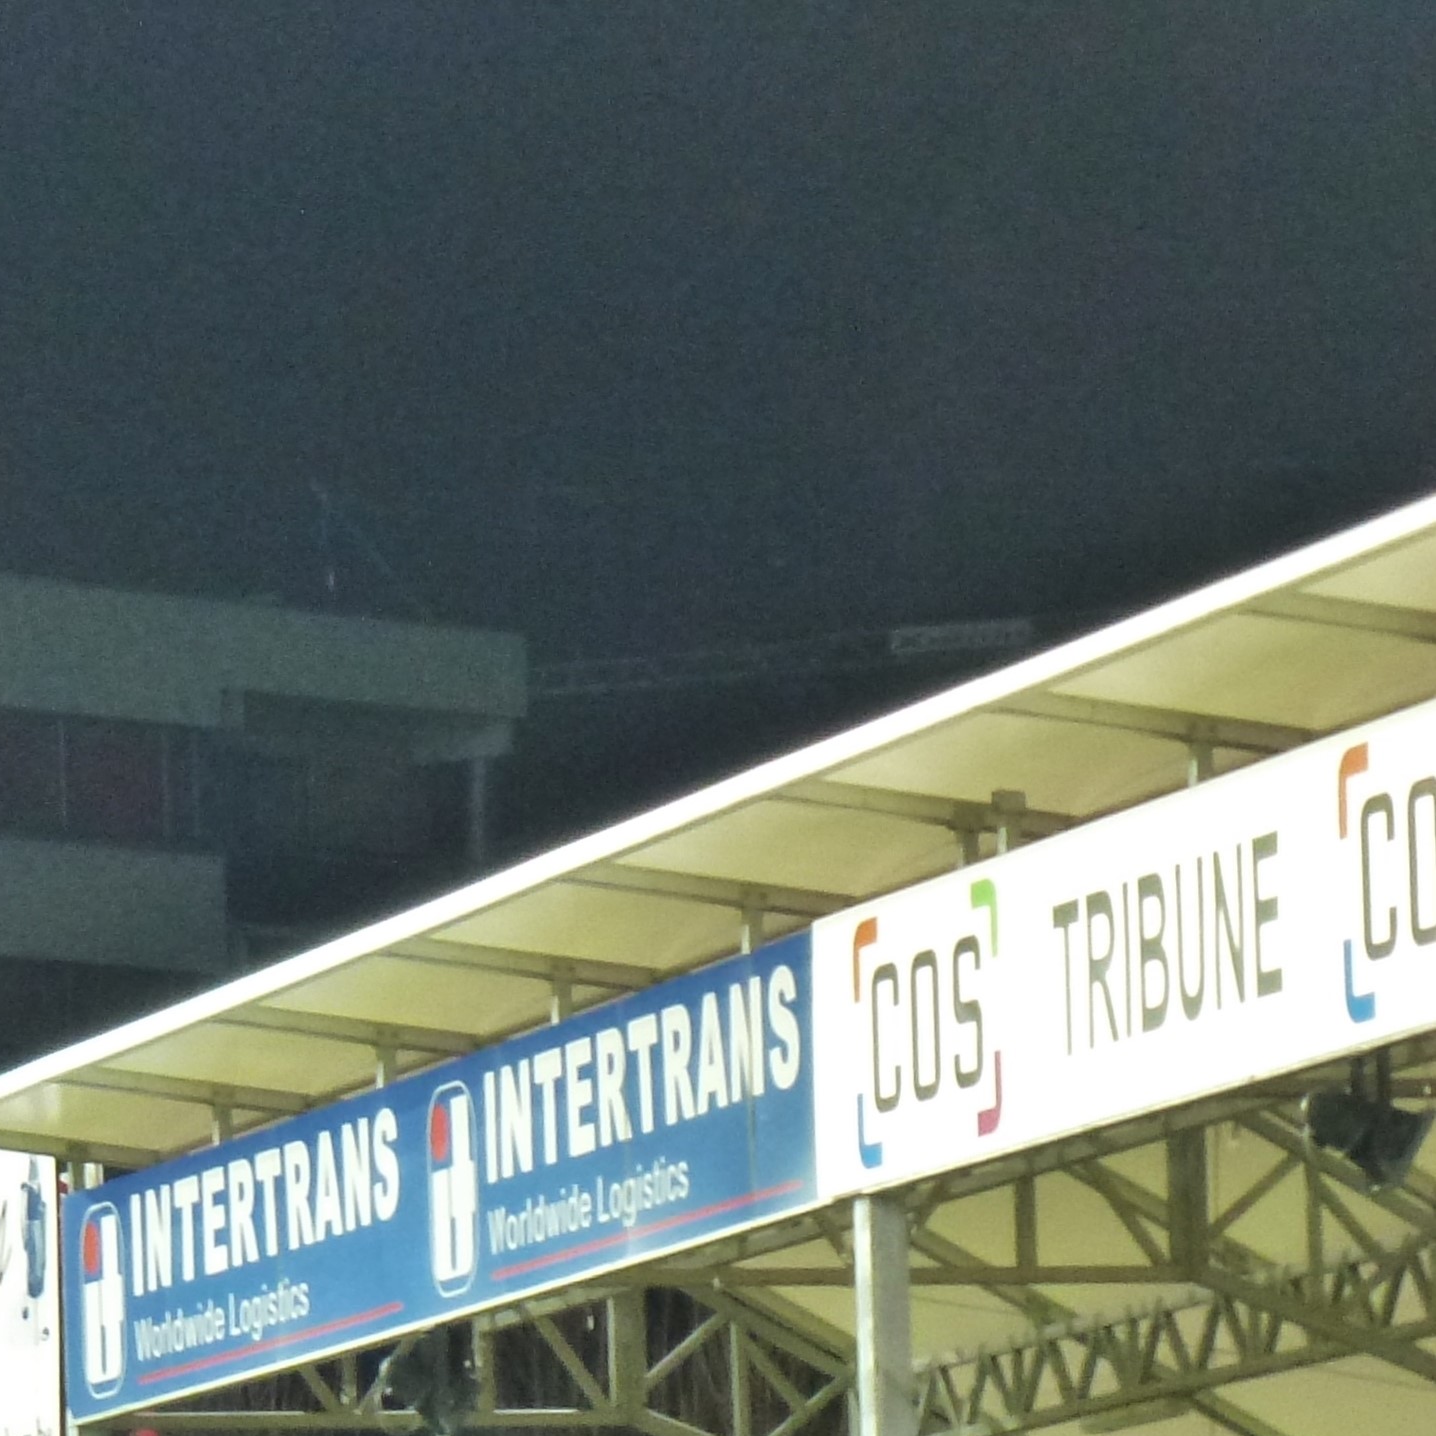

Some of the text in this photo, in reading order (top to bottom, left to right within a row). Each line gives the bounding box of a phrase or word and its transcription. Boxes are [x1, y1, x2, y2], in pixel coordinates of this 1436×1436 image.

[871, 831, 1283, 1113] COS TRIBUNE
[483, 965, 801, 1185] INTERTRANS
[130, 1107, 400, 1297] INTERTRANS
[488, 1157, 689, 1256] Worldwide Logistics
[134, 1277, 309, 1362] Worldwide Logistics
